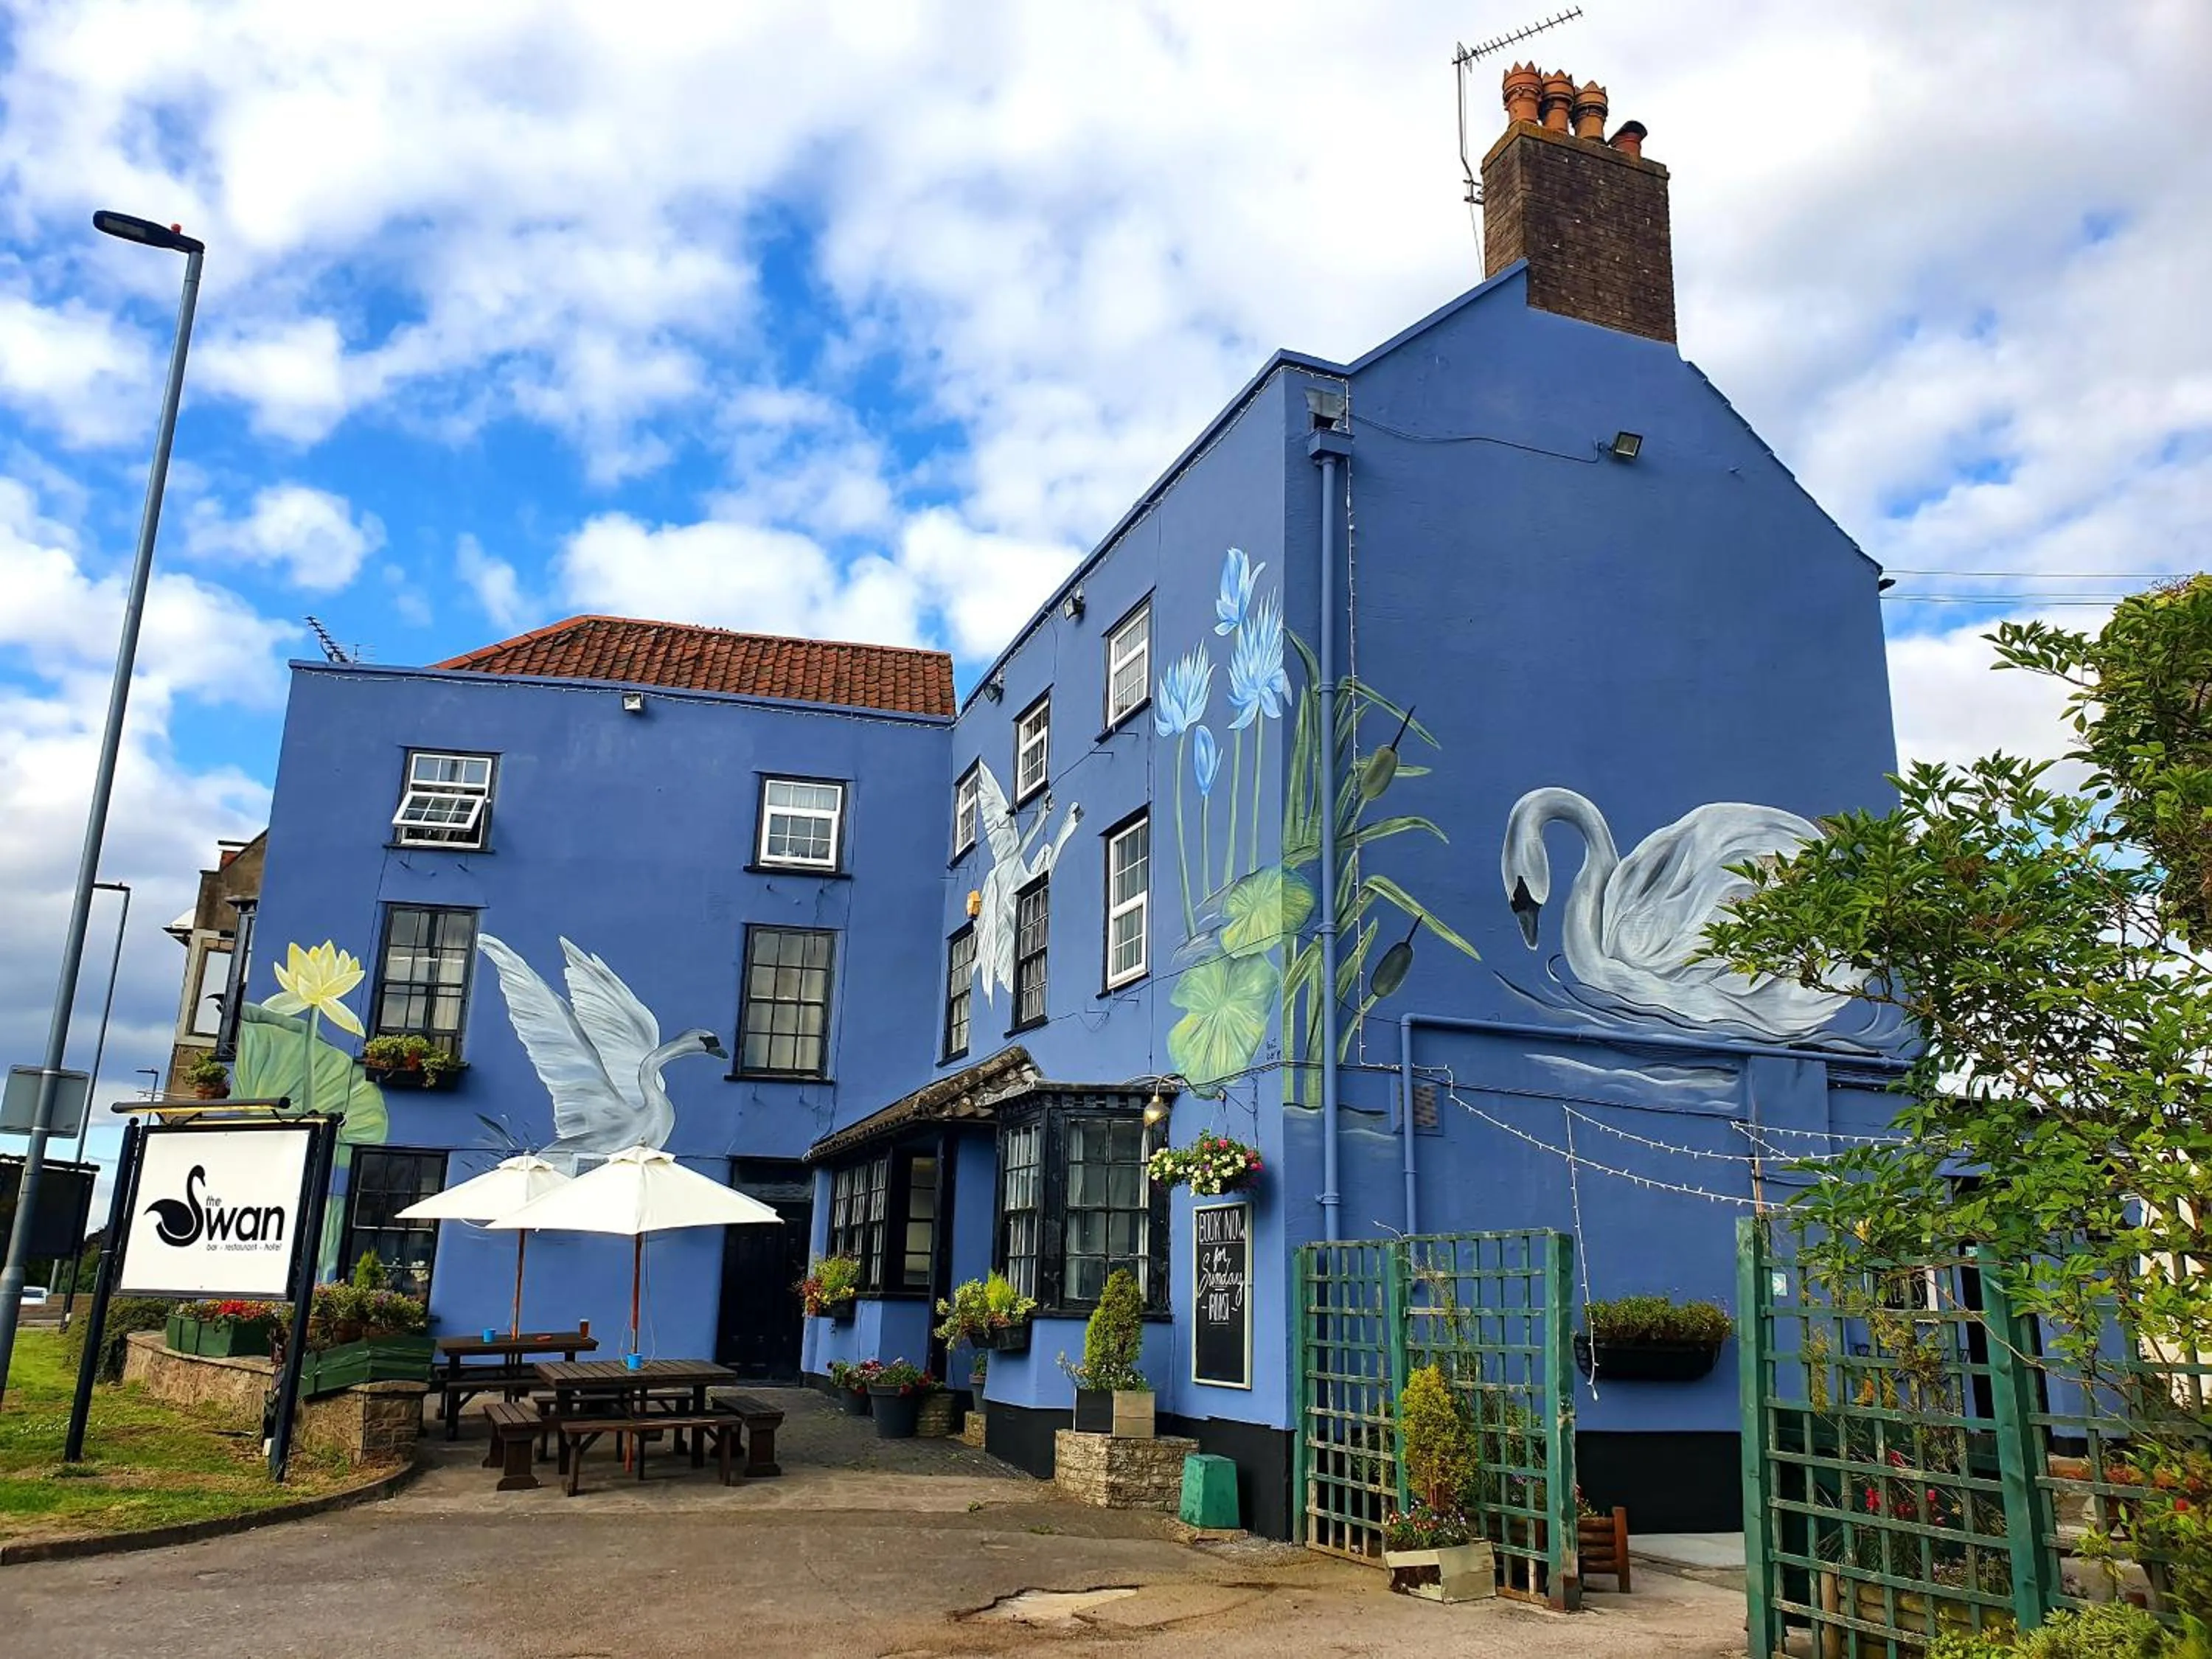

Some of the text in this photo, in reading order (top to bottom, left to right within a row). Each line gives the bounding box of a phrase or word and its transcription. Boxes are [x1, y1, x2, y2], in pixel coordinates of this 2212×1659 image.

[206, 1195, 222, 1207] the
[1199, 1209, 1246, 1242] BOOK NOW
[206, 1243, 218, 1251] bar
[224, 1243, 258, 1251] restaurant
[264, 1242, 282, 1251] hotel
[1213, 1246, 1227, 1273] for
[1198, 1252, 1245, 1307] Sunday
